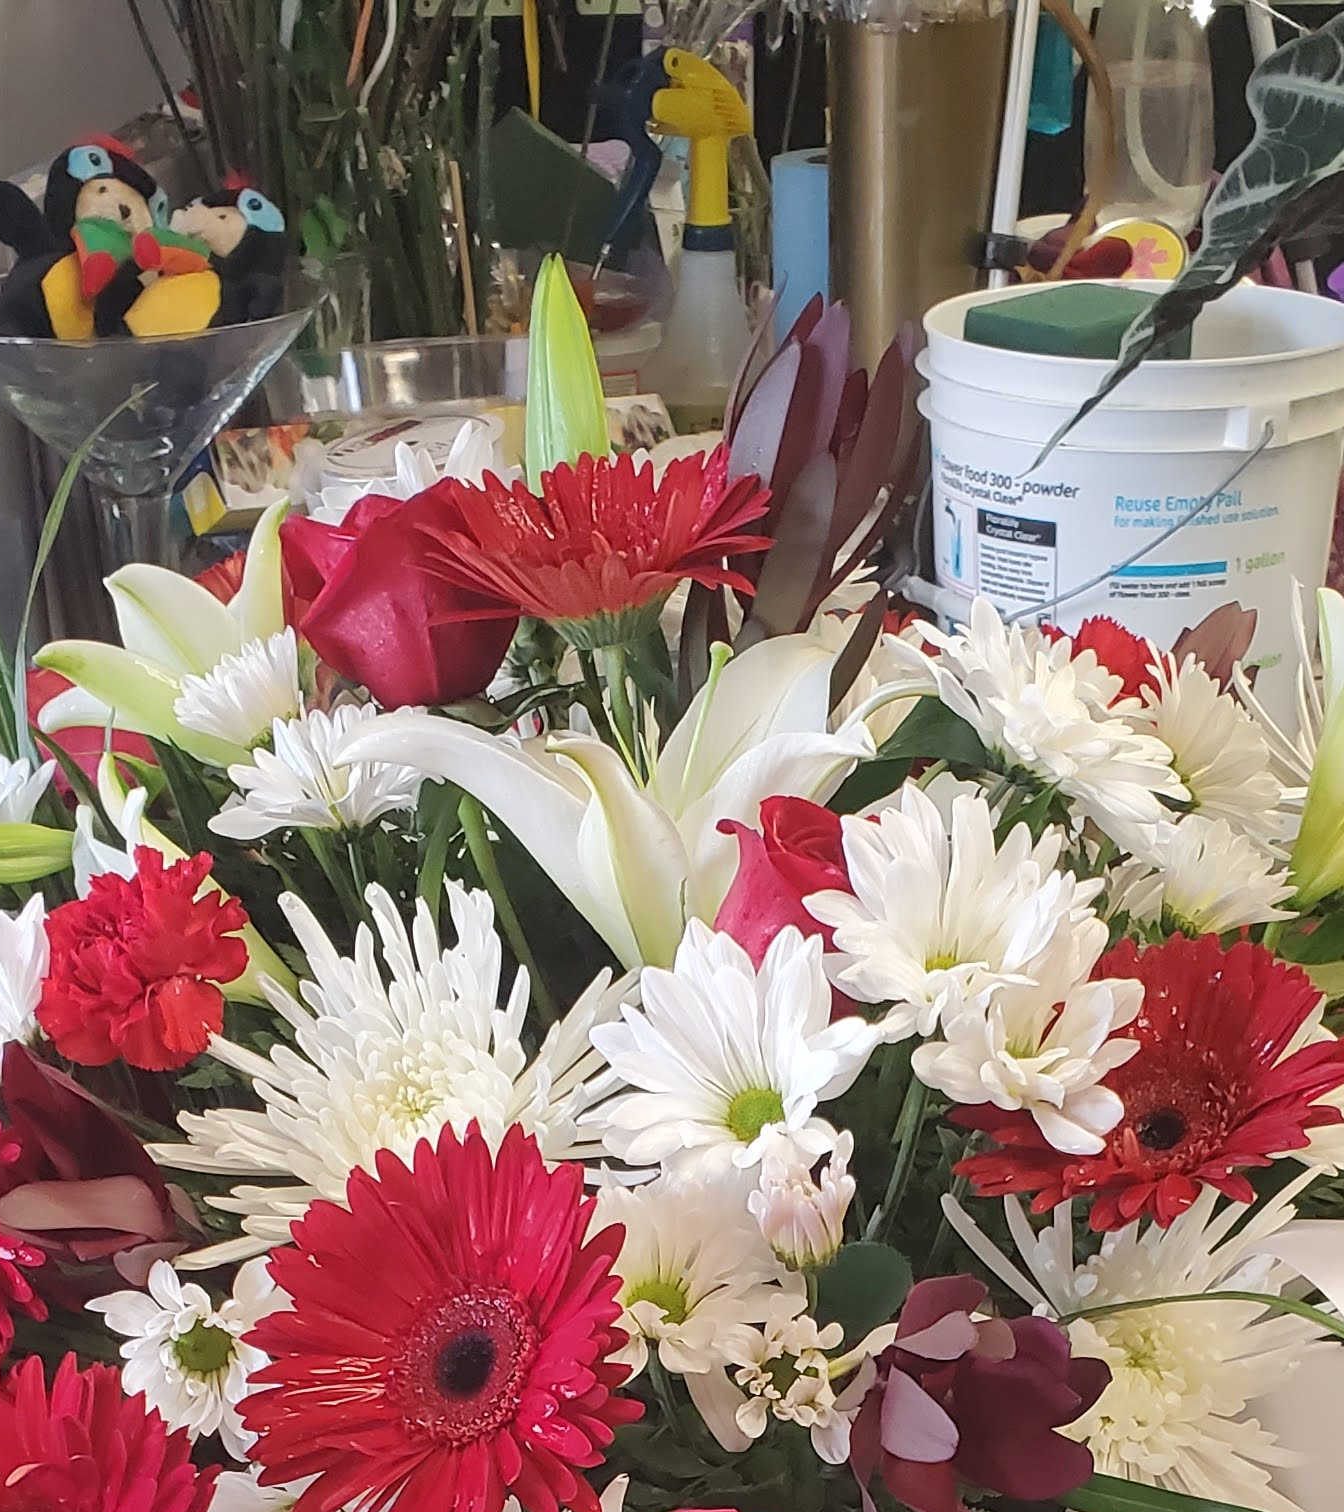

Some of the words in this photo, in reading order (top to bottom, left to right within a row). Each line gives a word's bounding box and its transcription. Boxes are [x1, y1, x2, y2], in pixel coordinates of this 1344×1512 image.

[989, 472, 1012, 490] 300
[1022, 481, 1080, 499] powder
[1114, 496, 1161, 513] Reuse
[1216, 490, 1242, 508] Pail
